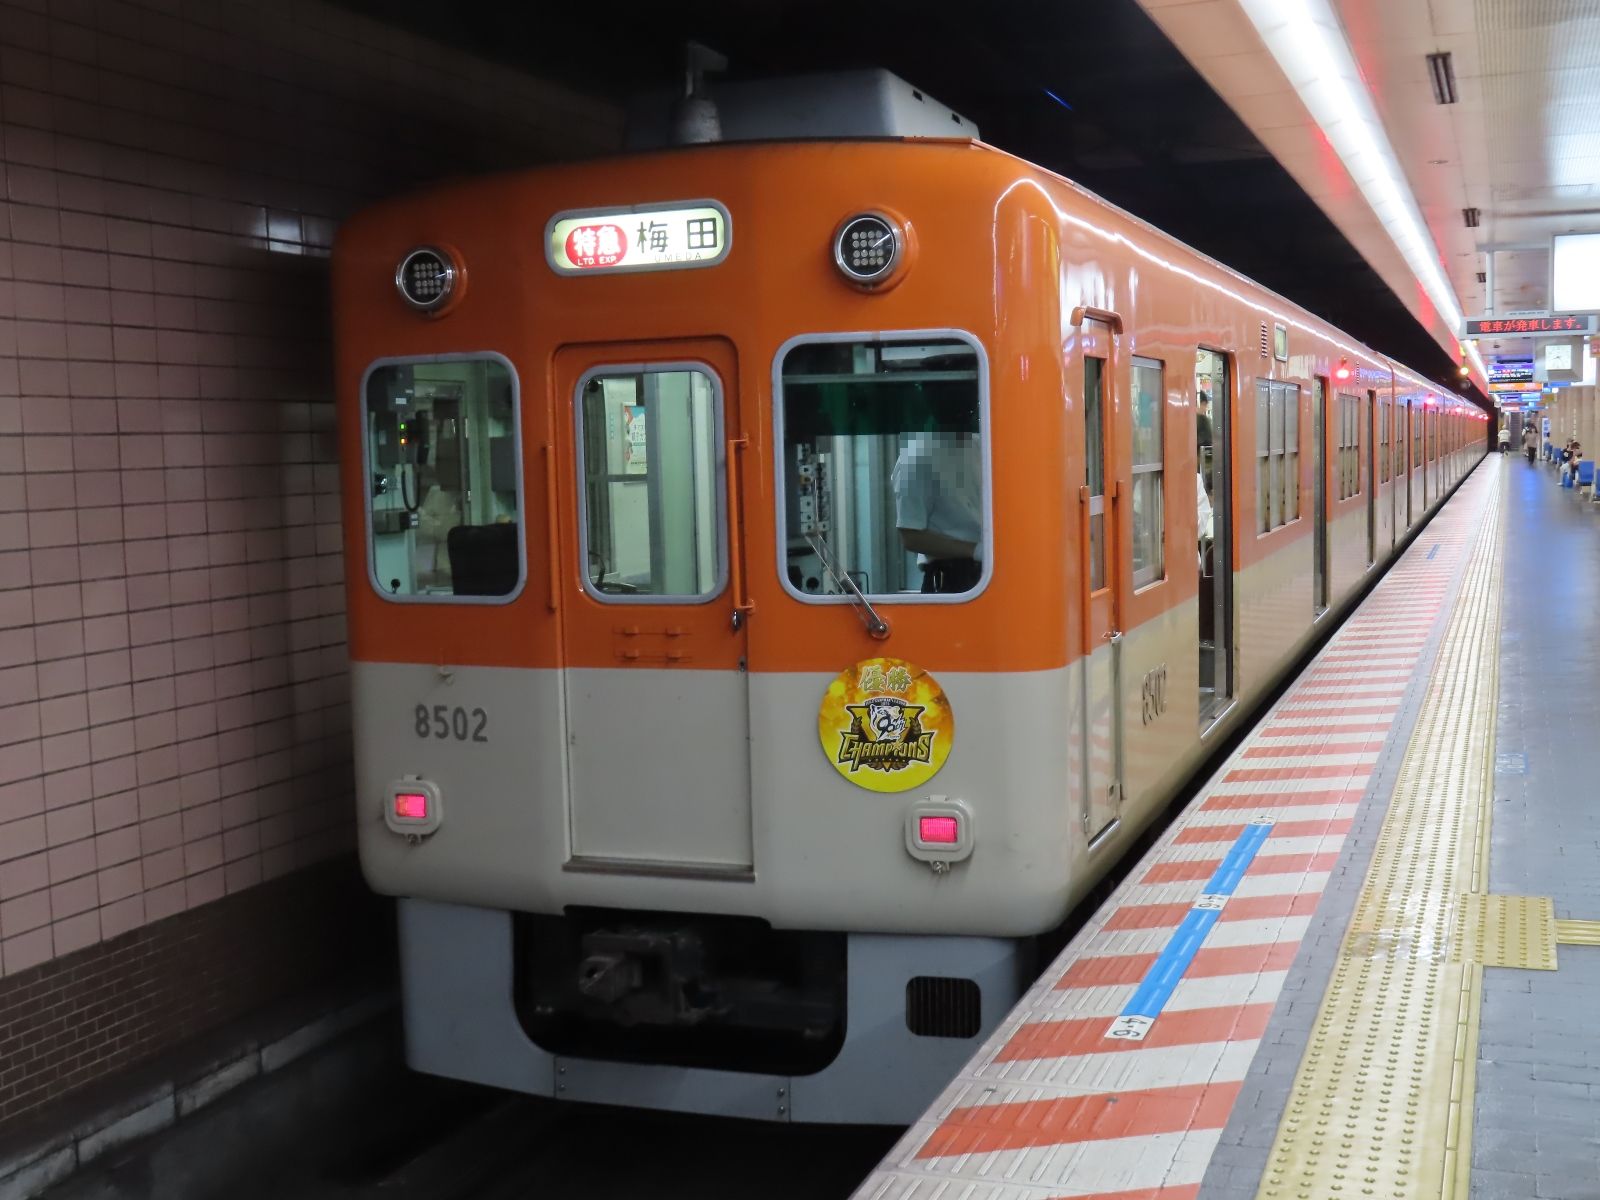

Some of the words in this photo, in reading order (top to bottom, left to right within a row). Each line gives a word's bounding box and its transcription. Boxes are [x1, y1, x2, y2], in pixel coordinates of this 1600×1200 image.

[573, 226, 621, 256] 特急
[637, 217, 717, 253] 梅田
[655, 252, 702, 263] UMEDA
[1480, 317, 1582, 332] 電車が発車します。
[415, 703, 488, 742] 8502
[838, 731, 934, 772] CHAMPIONS
